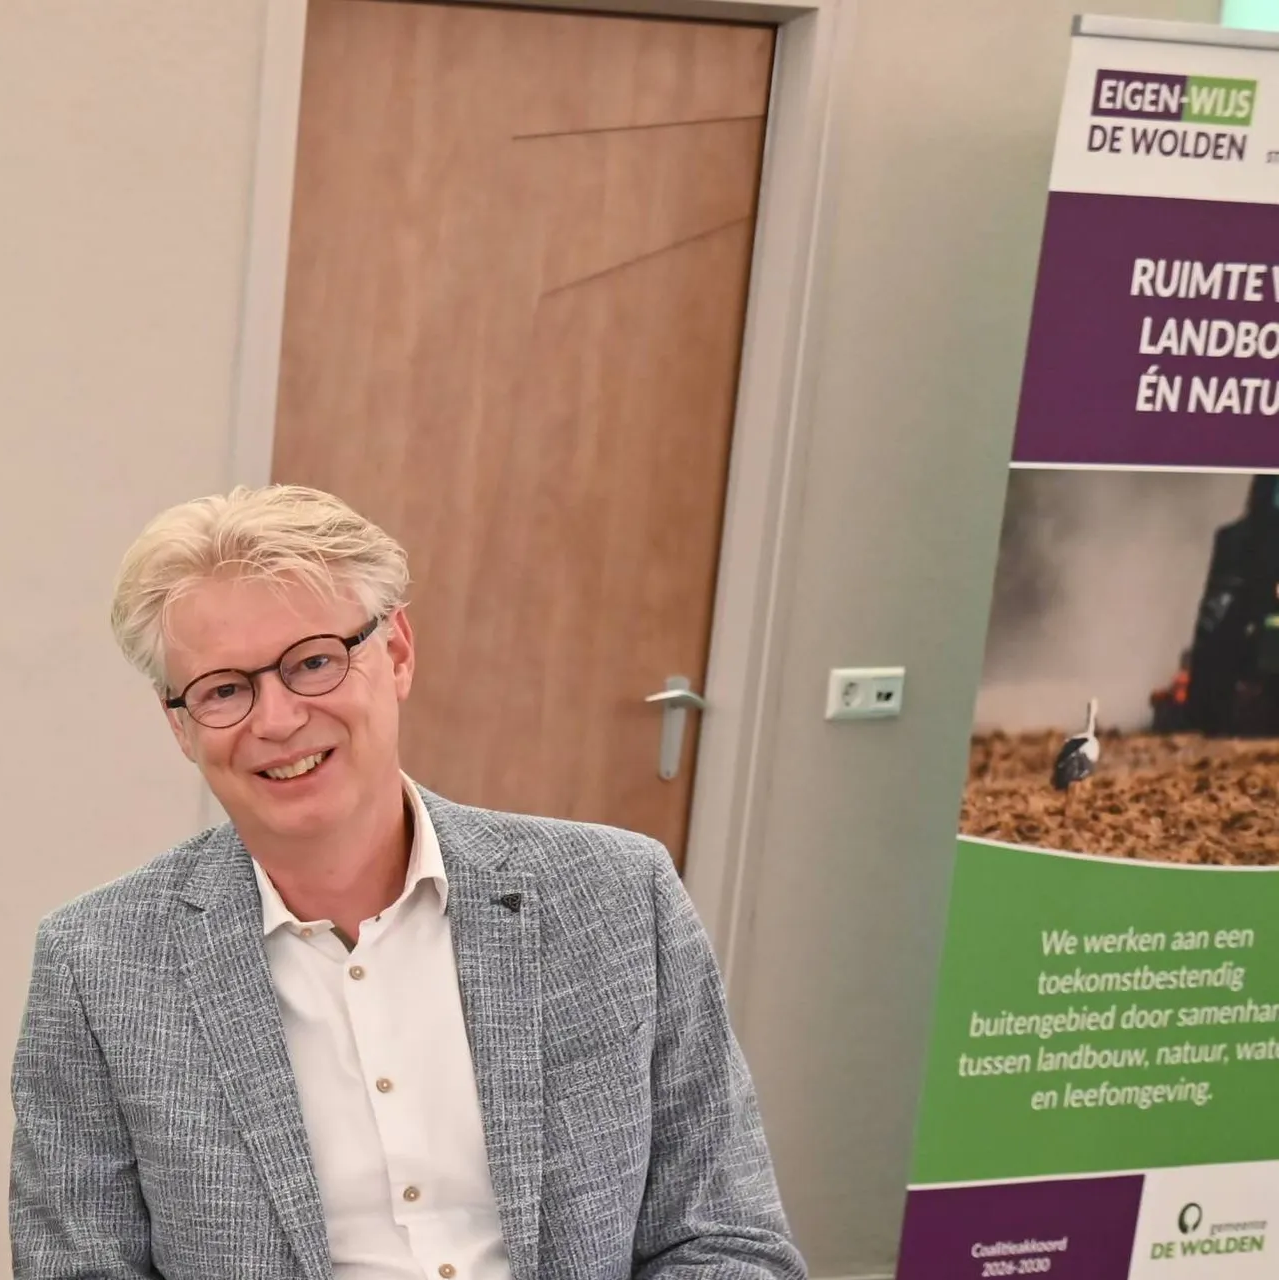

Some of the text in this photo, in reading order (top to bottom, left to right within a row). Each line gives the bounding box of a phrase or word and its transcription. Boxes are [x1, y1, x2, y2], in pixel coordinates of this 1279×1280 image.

[1098, 79, 1252, 118] EIGEN-WIJS
[1088, 125, 1124, 153] DE
[1131, 127, 1248, 161] WOLDEN
[1130, 258, 1267, 302] RUIMTE
[1135, 364, 1181, 413] ÉN
[1041, 926, 1254, 956] We werken aan een
[1037, 961, 1246, 995] toekomstbestendig
[969, 1005, 1117, 1039] buitengebied
[1120, 1003, 1173, 1030] door
[958, 1052, 1031, 1077] tussen
[1037, 1044, 1149, 1073] landbouw,
[1156, 1041, 1229, 1066] natuur,
[1031, 1078, 1213, 1111] en leefomgeving.
[1150, 1235, 1265, 1260] DE WOLDEN
